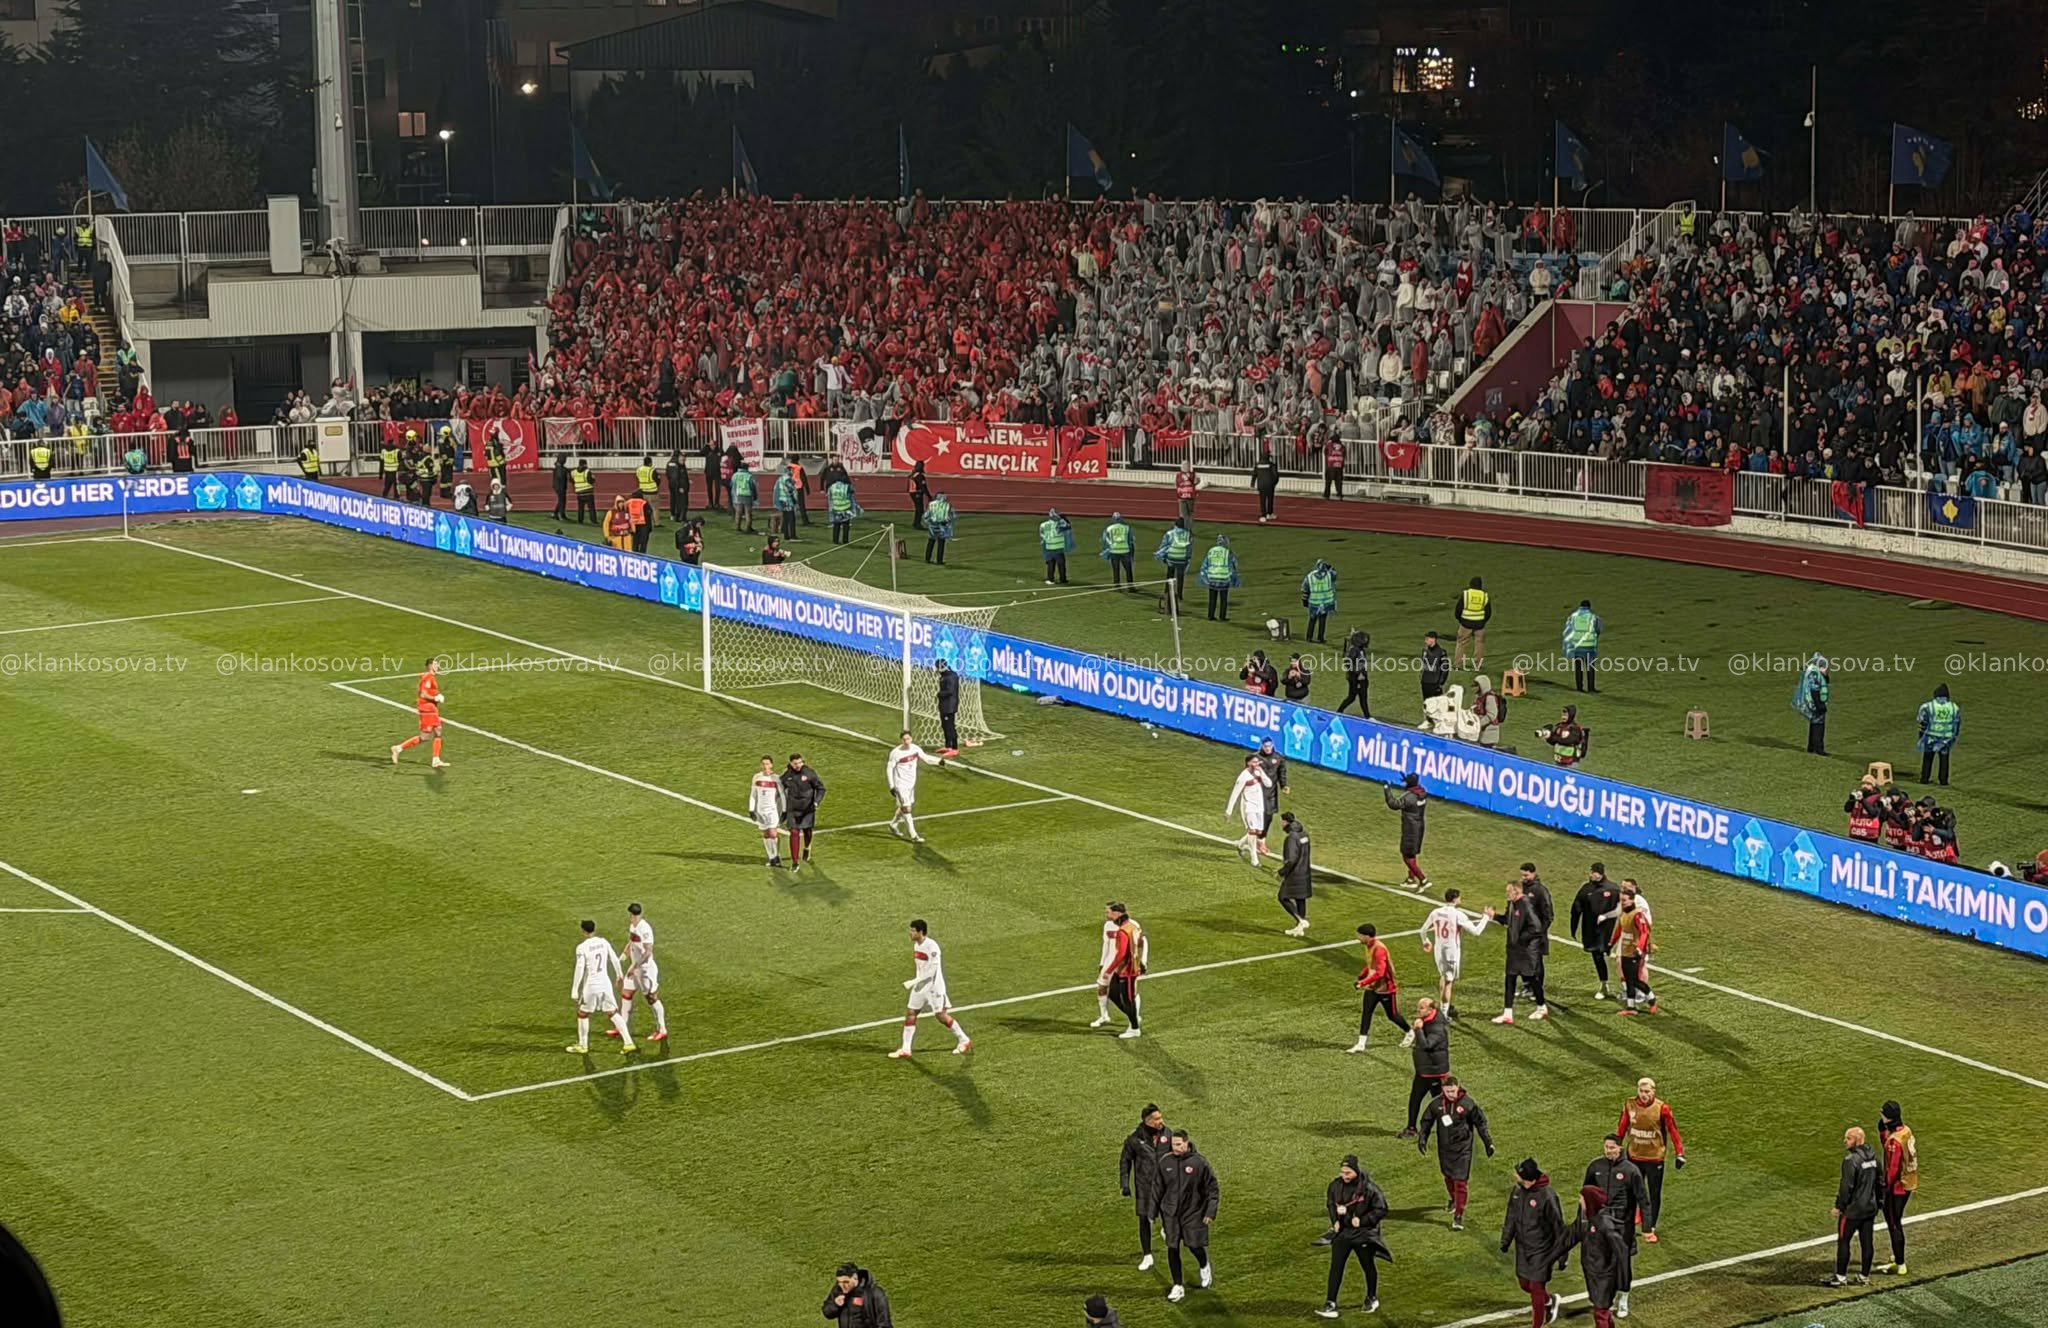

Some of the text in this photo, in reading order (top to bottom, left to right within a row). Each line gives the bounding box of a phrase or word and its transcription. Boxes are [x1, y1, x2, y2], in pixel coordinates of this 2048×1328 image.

[960, 451, 1039, 475] GENÇLİK
[1067, 459, 1100, 474] 1942
[0, 477, 189, 508] DUĞU HER YERDE
[302, 488, 340, 516] TAKIMIN
[341, 496, 381, 523] OLDUĞU
[382, 503, 400, 526] HER
[402, 506, 434, 531] YERDE
[500, 530, 544, 562] TAKIMIN
[546, 540, 593, 574] OLDUĞU
[595, 549, 617, 576] HER
[618, 554, 658, 584] YERDE
[739, 589, 793, 622] TAKIMIN
[795, 600, 853, 633] OLDUĞU
[856, 616, 883, 638] HER
[1032, 656, 1099, 694] TAKIMIN
[1102, 671, 1178, 712] OLDUĞU
[1181, 688, 1217, 720] HER
[1221, 694, 1282, 732] YERDE
[1413, 747, 1493, 793] TAKIMIN
[1499, 769, 1594, 817] OLDUĞU
[1600, 789, 1646, 828] HER
[1651, 797, 1730, 845] YERDE
[1902, 870, 2016, 929] TAKIMIN
[1435, 919, 1449, 939] 16
